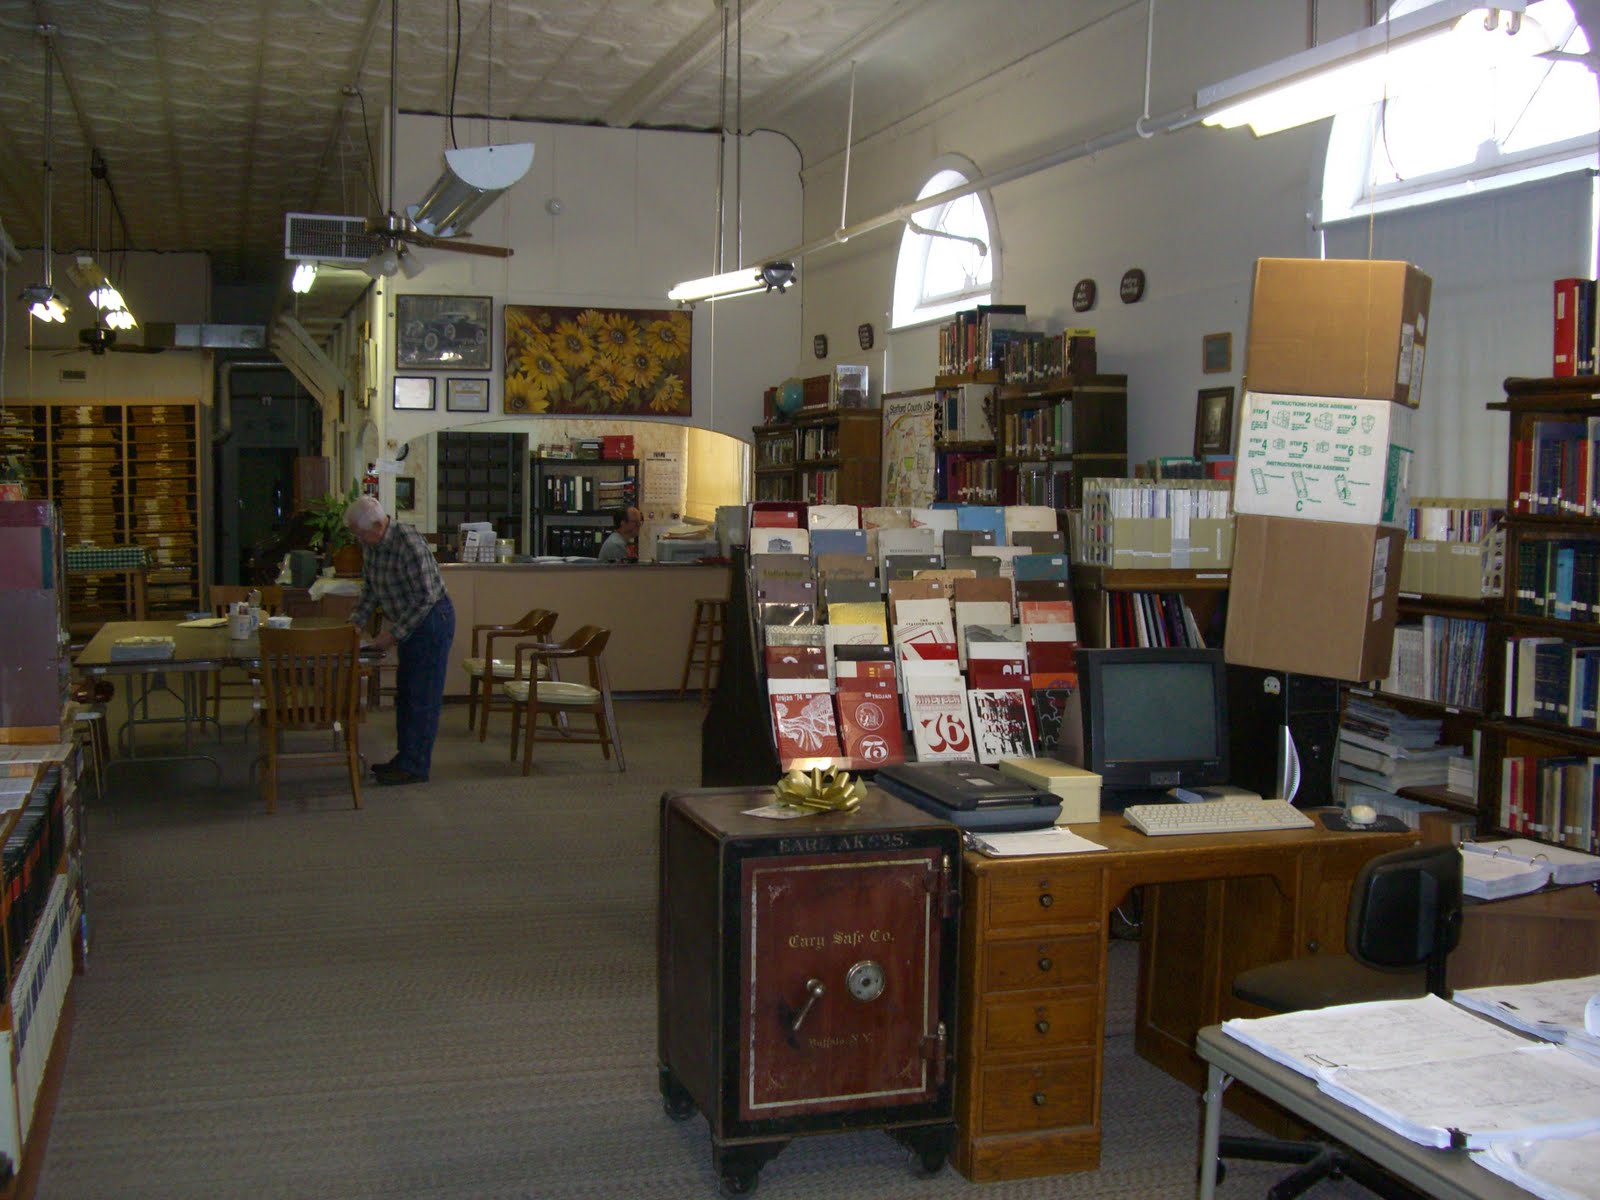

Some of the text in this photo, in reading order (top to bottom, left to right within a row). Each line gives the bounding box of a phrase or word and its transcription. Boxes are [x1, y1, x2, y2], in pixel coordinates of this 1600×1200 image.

[1305, 412, 1311, 423] 2
[1351, 415, 1357, 426] 3
[1261, 439, 1267, 450] 4
[1302, 442, 1308, 453] 5
[1348, 445, 1354, 456] 6
[1266, 460, 1302, 468] INSTRUCTIONS
[915, 694, 962, 705] NINETEEN
[920, 713, 970, 753] 76
[862, 740, 887, 758] 75
[788, 929, 895, 950] Cary Safe Co.
